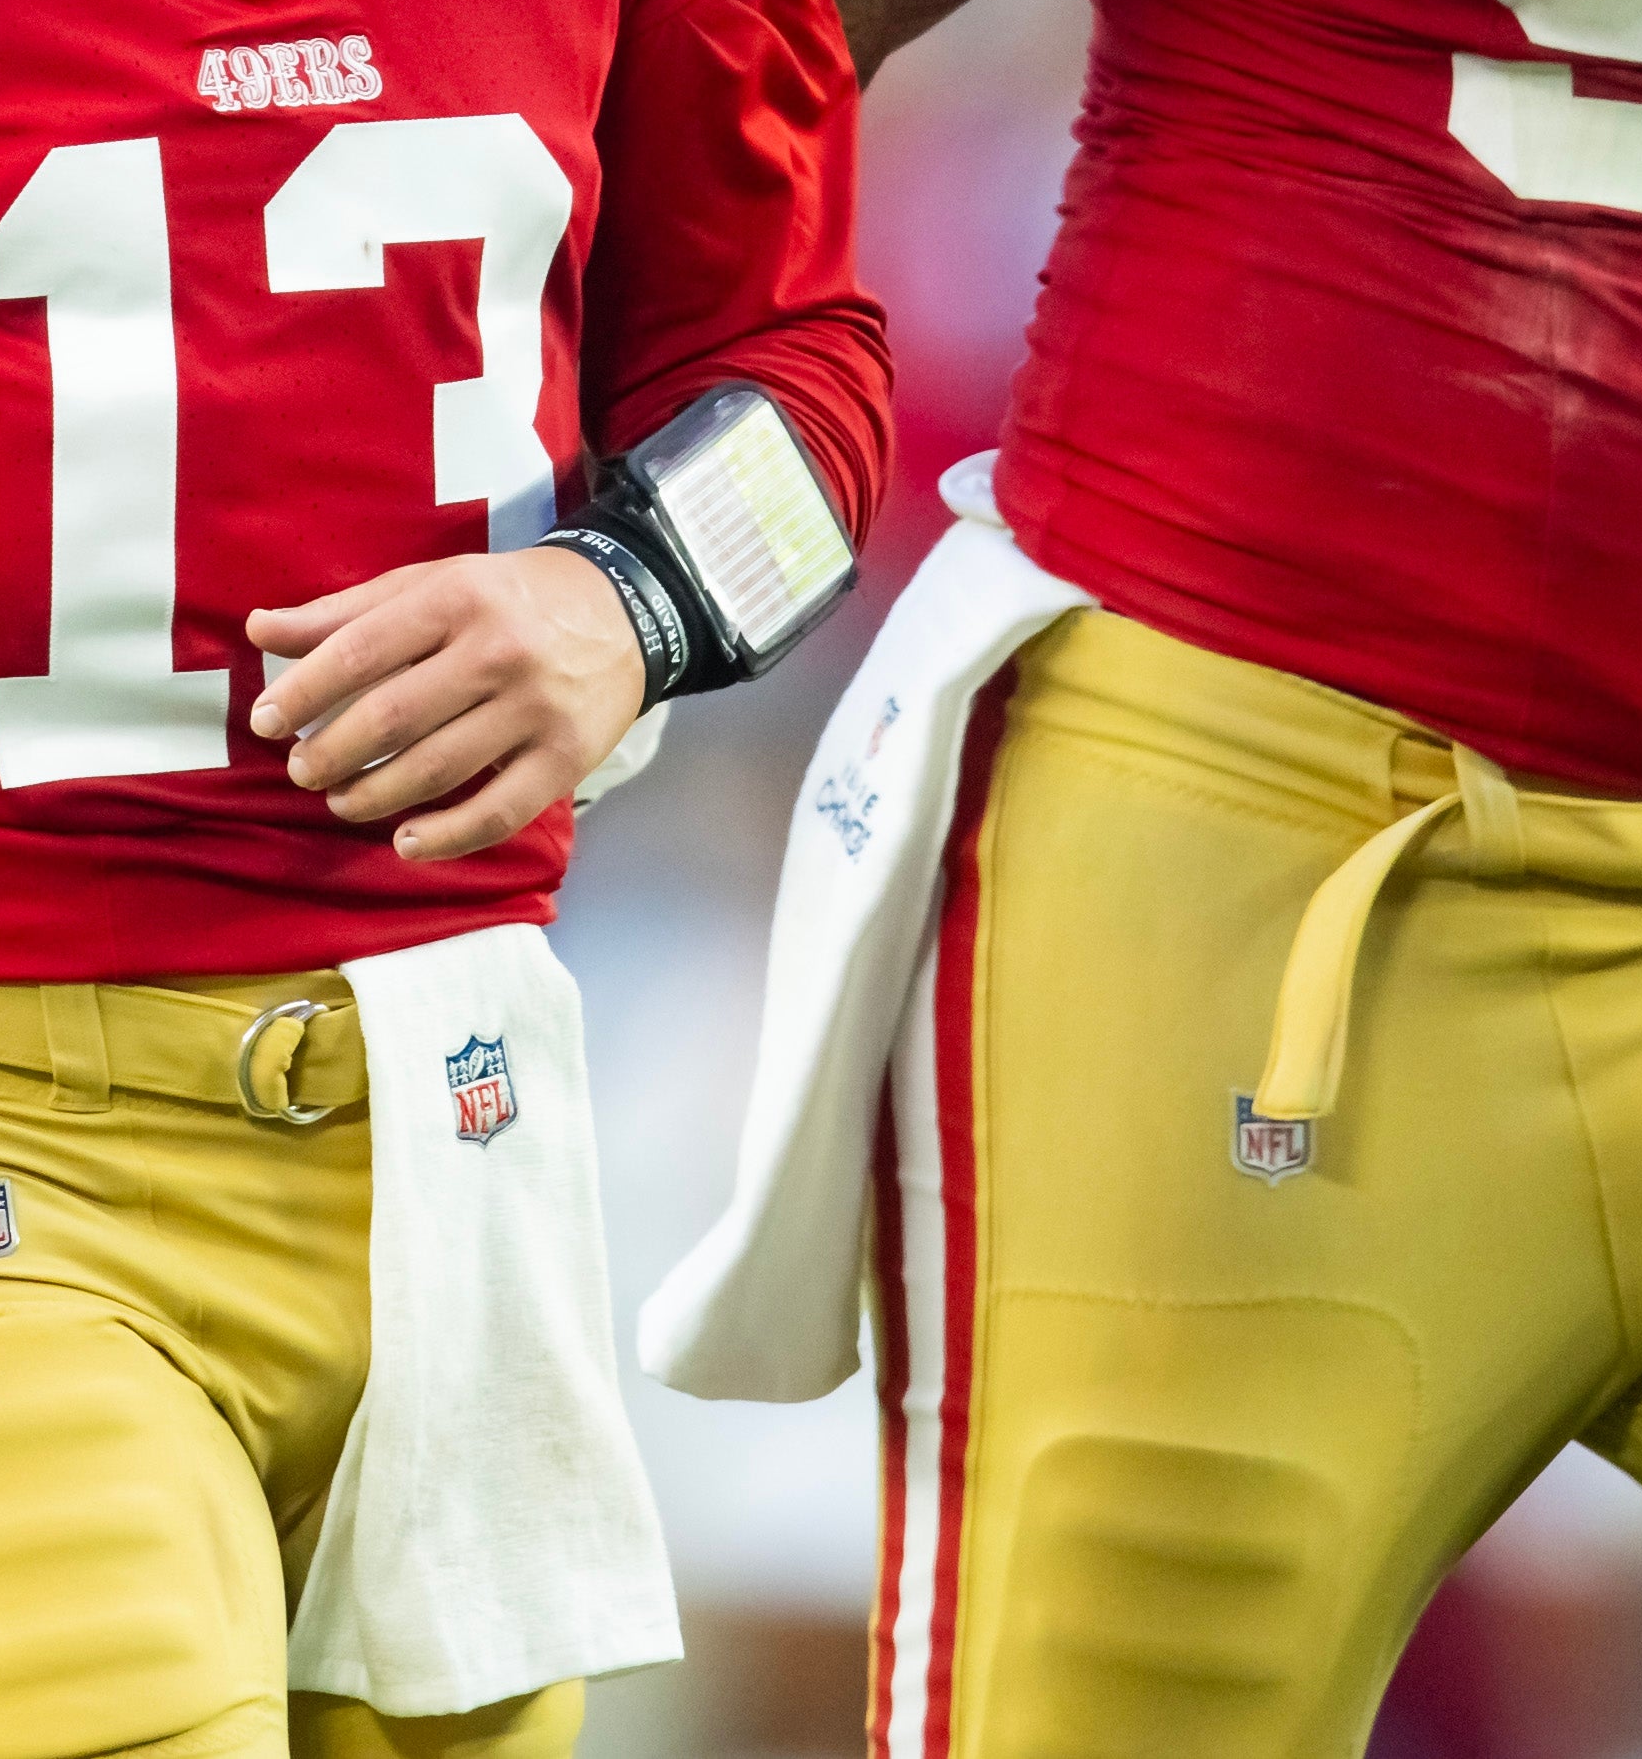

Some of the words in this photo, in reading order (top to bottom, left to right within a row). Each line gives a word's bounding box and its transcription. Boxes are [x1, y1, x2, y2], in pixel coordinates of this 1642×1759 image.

[197, 35, 383, 112] 49ERS
[651, 594, 681, 664] AFRAID
[455, 1080, 510, 1133] NFL
[1244, 1127, 1301, 1165] NFL
